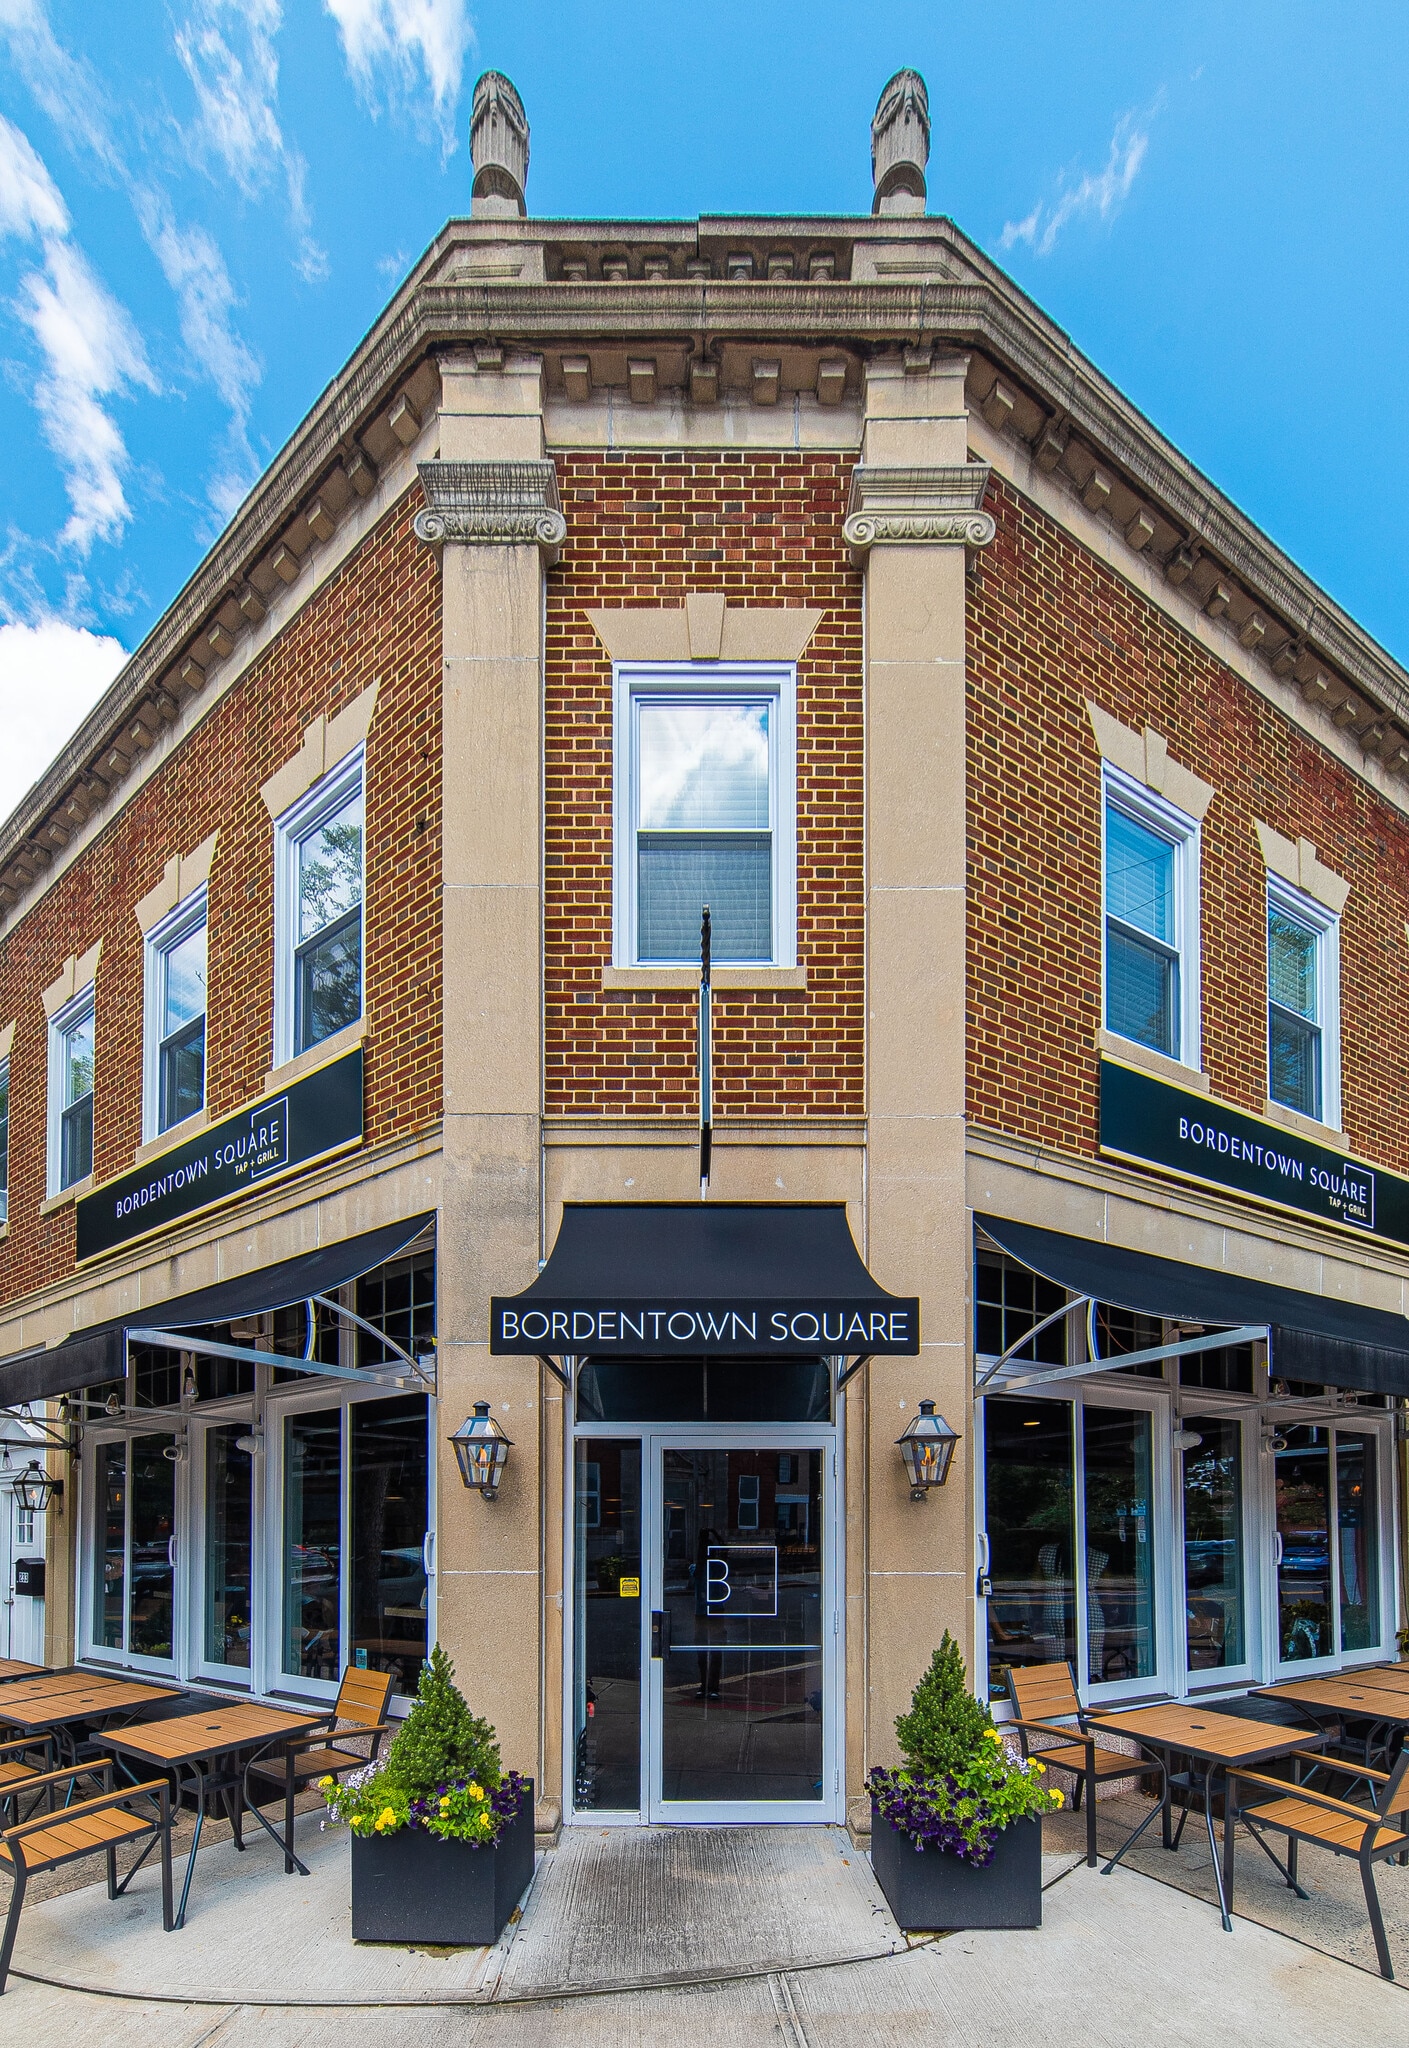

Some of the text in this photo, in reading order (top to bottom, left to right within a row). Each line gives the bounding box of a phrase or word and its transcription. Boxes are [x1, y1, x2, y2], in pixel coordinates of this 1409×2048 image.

[116, 1120, 279, 1218] BORDENTOWN SQUARE
[234, 1147, 279, 1175] TAP + GRILL
[1179, 1117, 1367, 1204] BORDENTOWN SQUARE
[1328, 1195, 1367, 1218] TAP + GRILL
[502, 1311, 909, 1341] BORDENTOWN SQUARE
[706, 1559, 731, 1603] B
